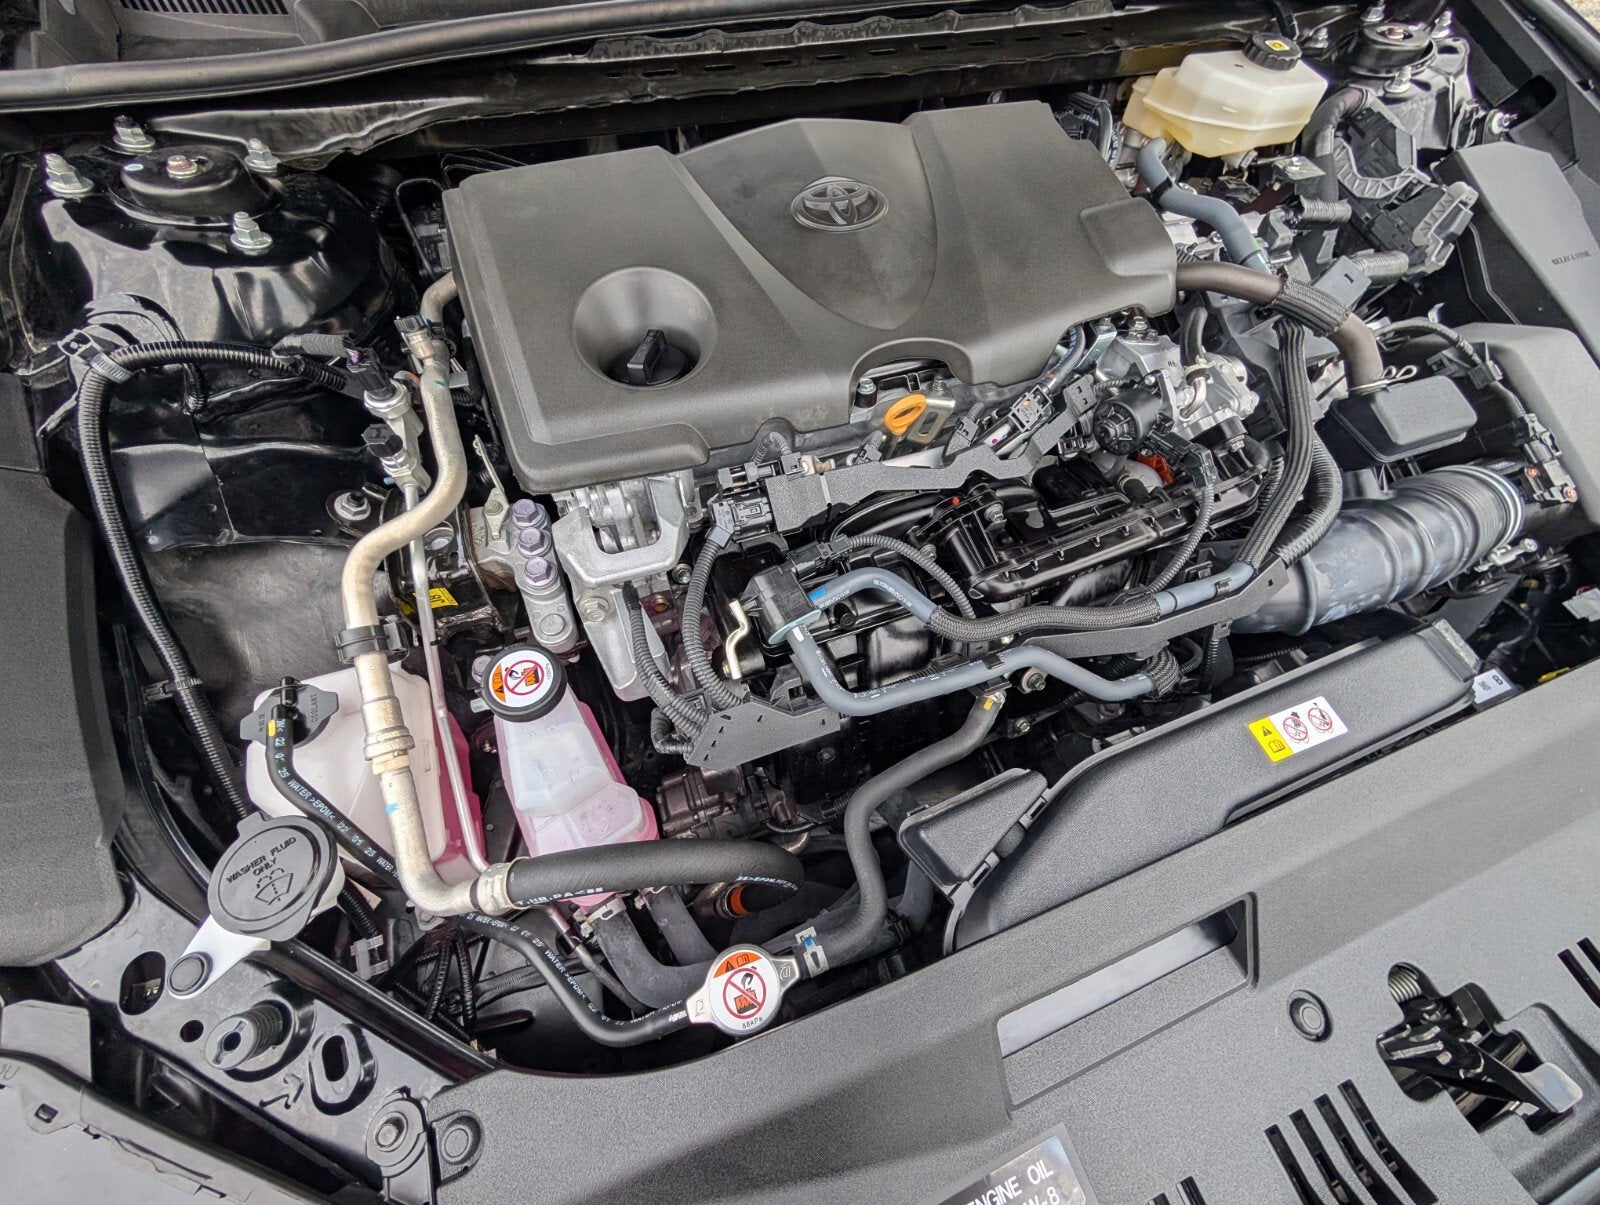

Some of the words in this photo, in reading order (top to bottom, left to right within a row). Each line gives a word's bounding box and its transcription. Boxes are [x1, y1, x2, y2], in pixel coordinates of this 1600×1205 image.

[310, 694, 319, 723] COOLANT
[287, 779, 312, 799] WATER
[226, 855, 267, 883] WASHER
[270, 836, 296, 856] FLUID
[253, 857, 276, 876] ONLY
[544, 949, 566, 973] WATER
[1027, 1160, 1054, 1185] OIL
